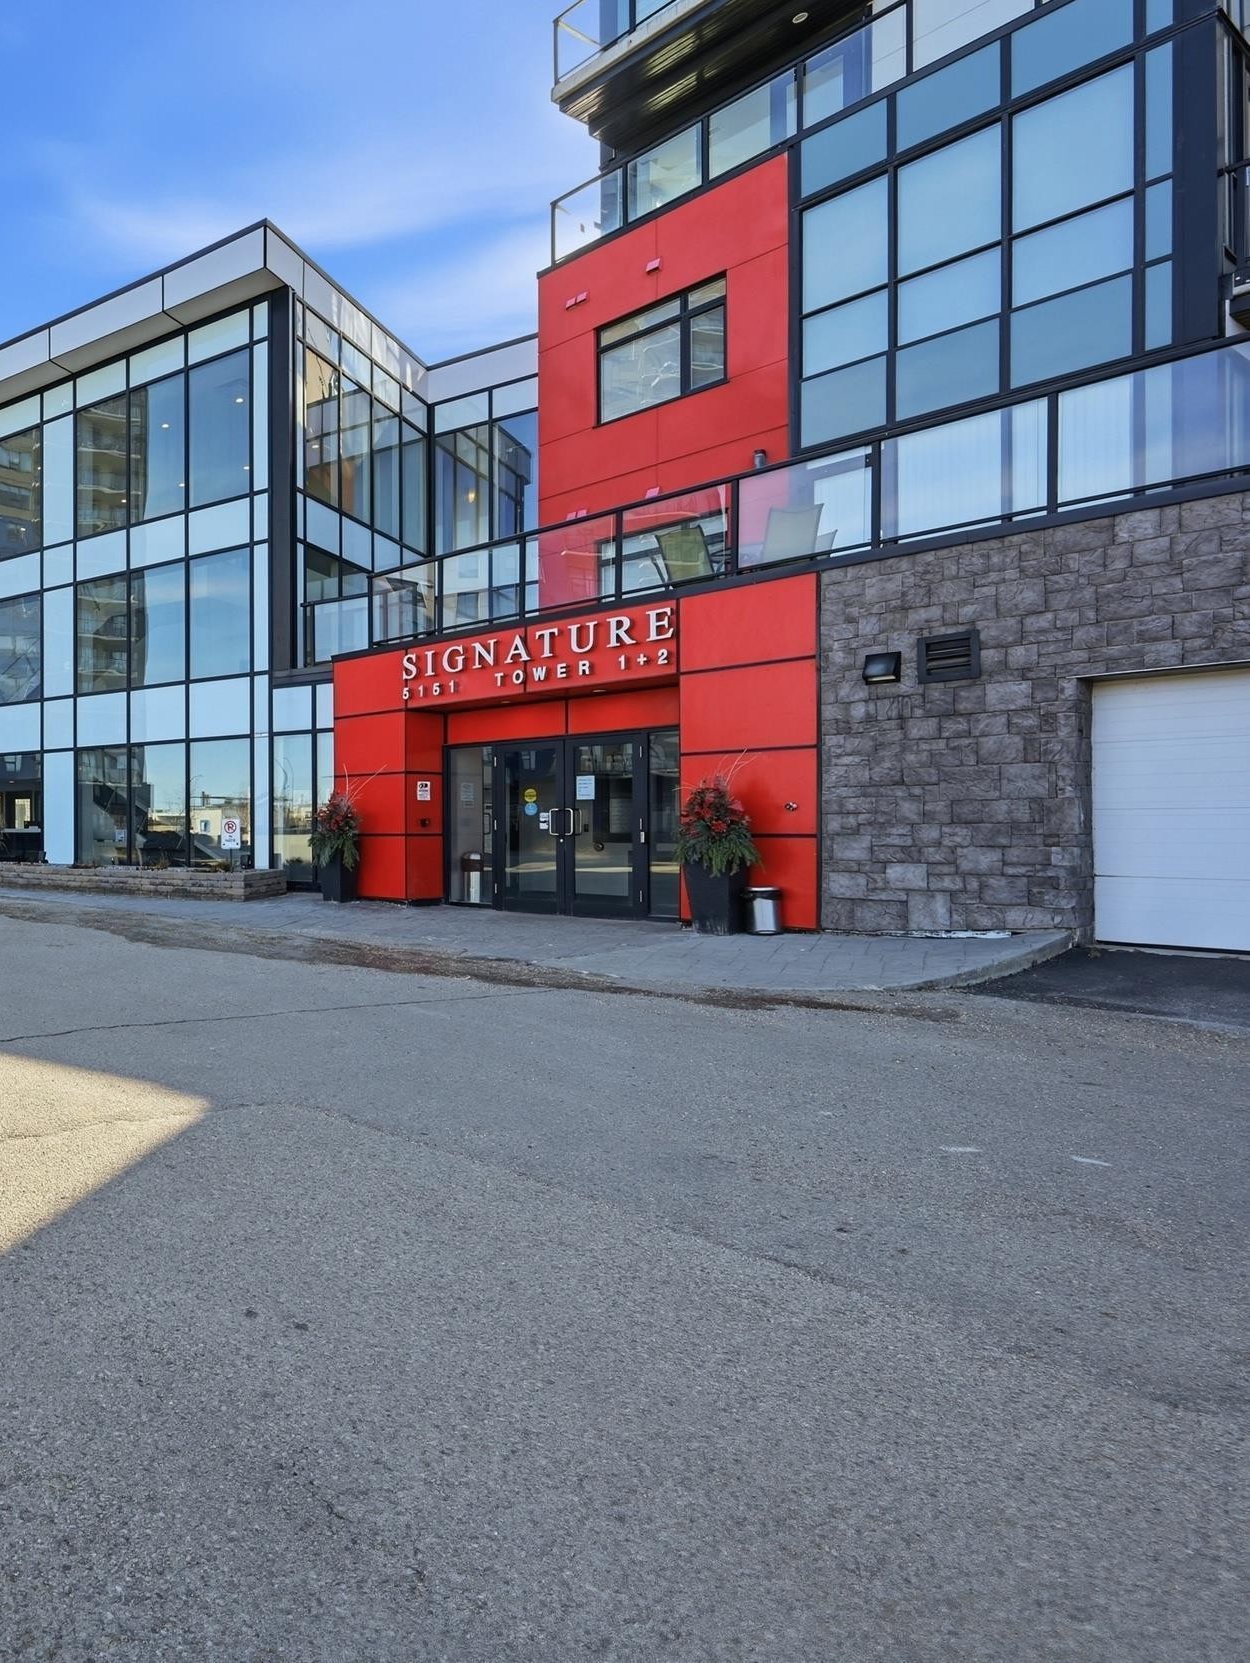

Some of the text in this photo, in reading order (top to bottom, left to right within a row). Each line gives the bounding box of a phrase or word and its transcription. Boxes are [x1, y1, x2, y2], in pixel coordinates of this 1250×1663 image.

[402, 607, 674, 680] SIGNATURE
[402, 680, 456, 700] 5151
[494, 660, 590, 687] TOWER
